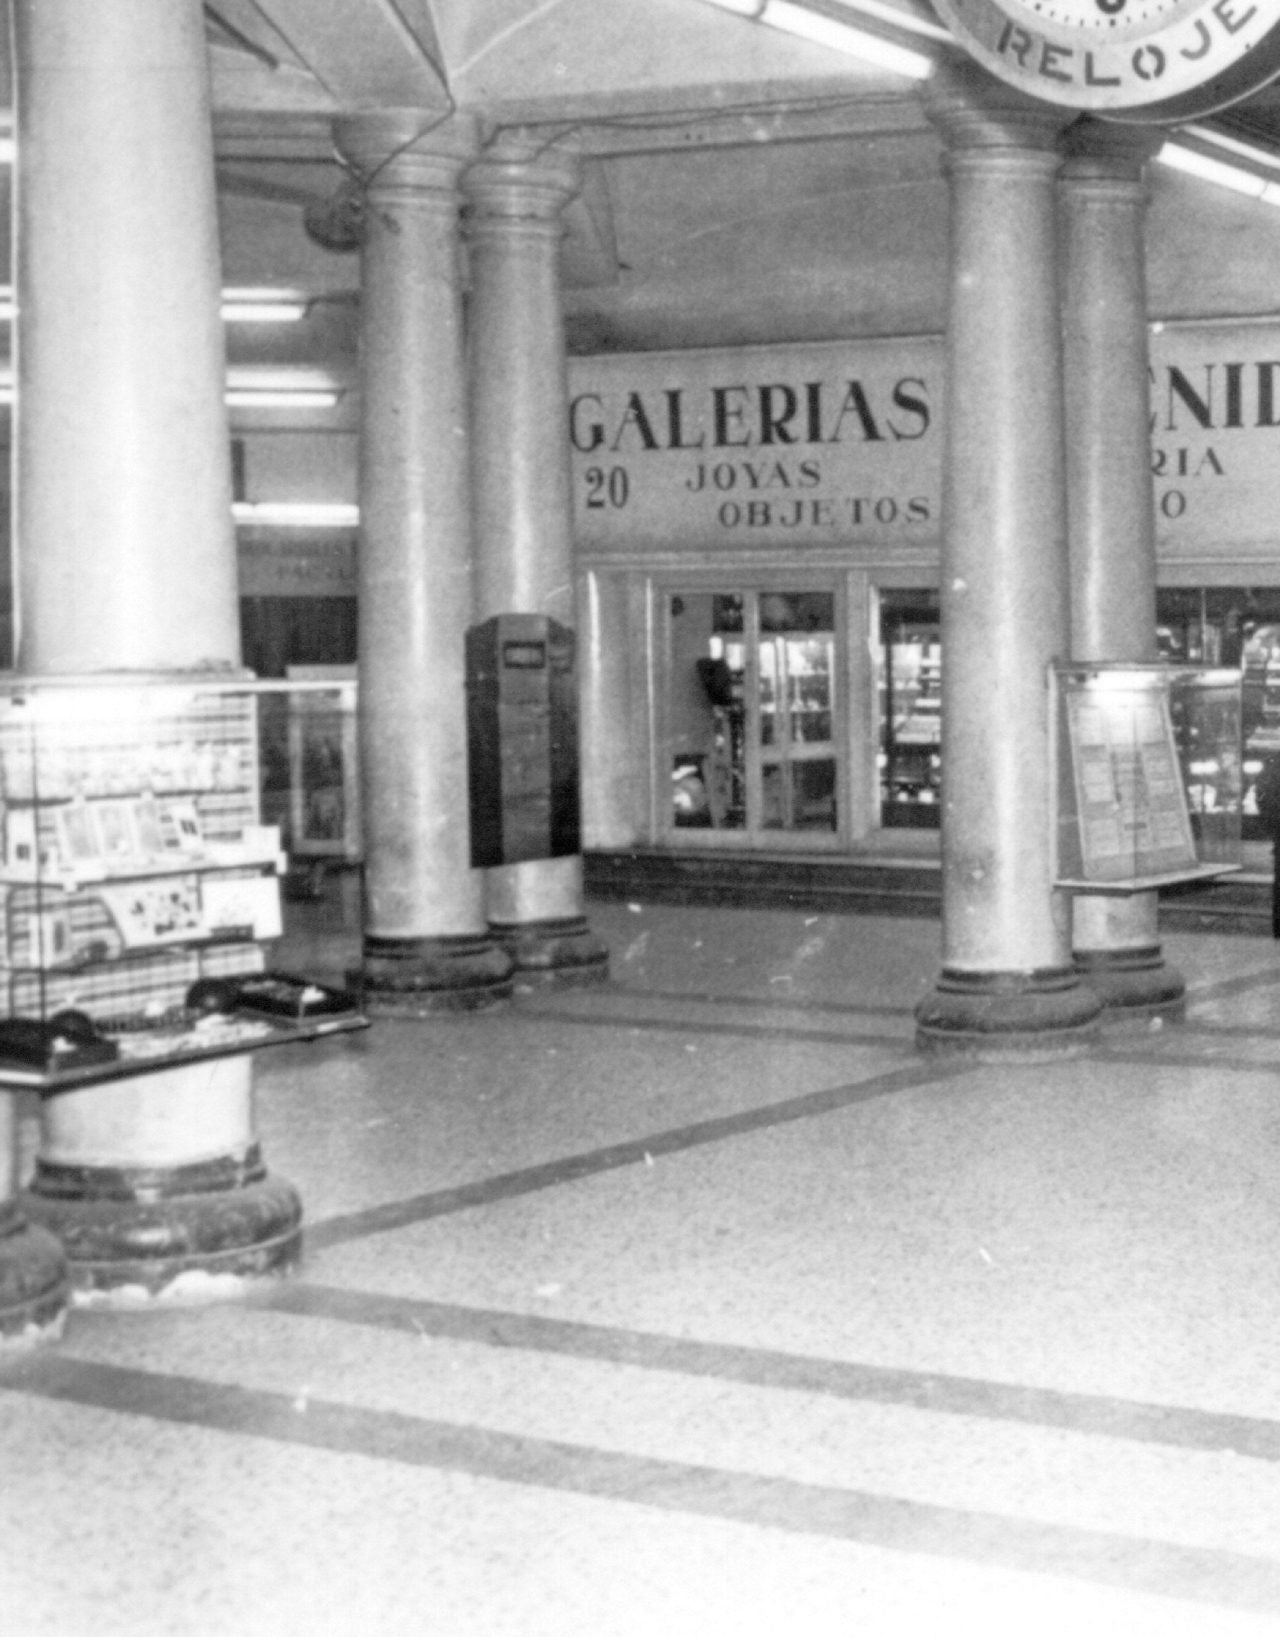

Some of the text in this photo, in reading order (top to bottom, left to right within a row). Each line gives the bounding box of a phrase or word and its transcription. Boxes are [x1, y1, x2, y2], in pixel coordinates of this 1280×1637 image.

[569, 377, 930, 452] GALERIAS
[585, 466, 629, 509] 20
[685, 460, 821, 492] JOYAS
[718, 497, 930, 528] OBJETOS
